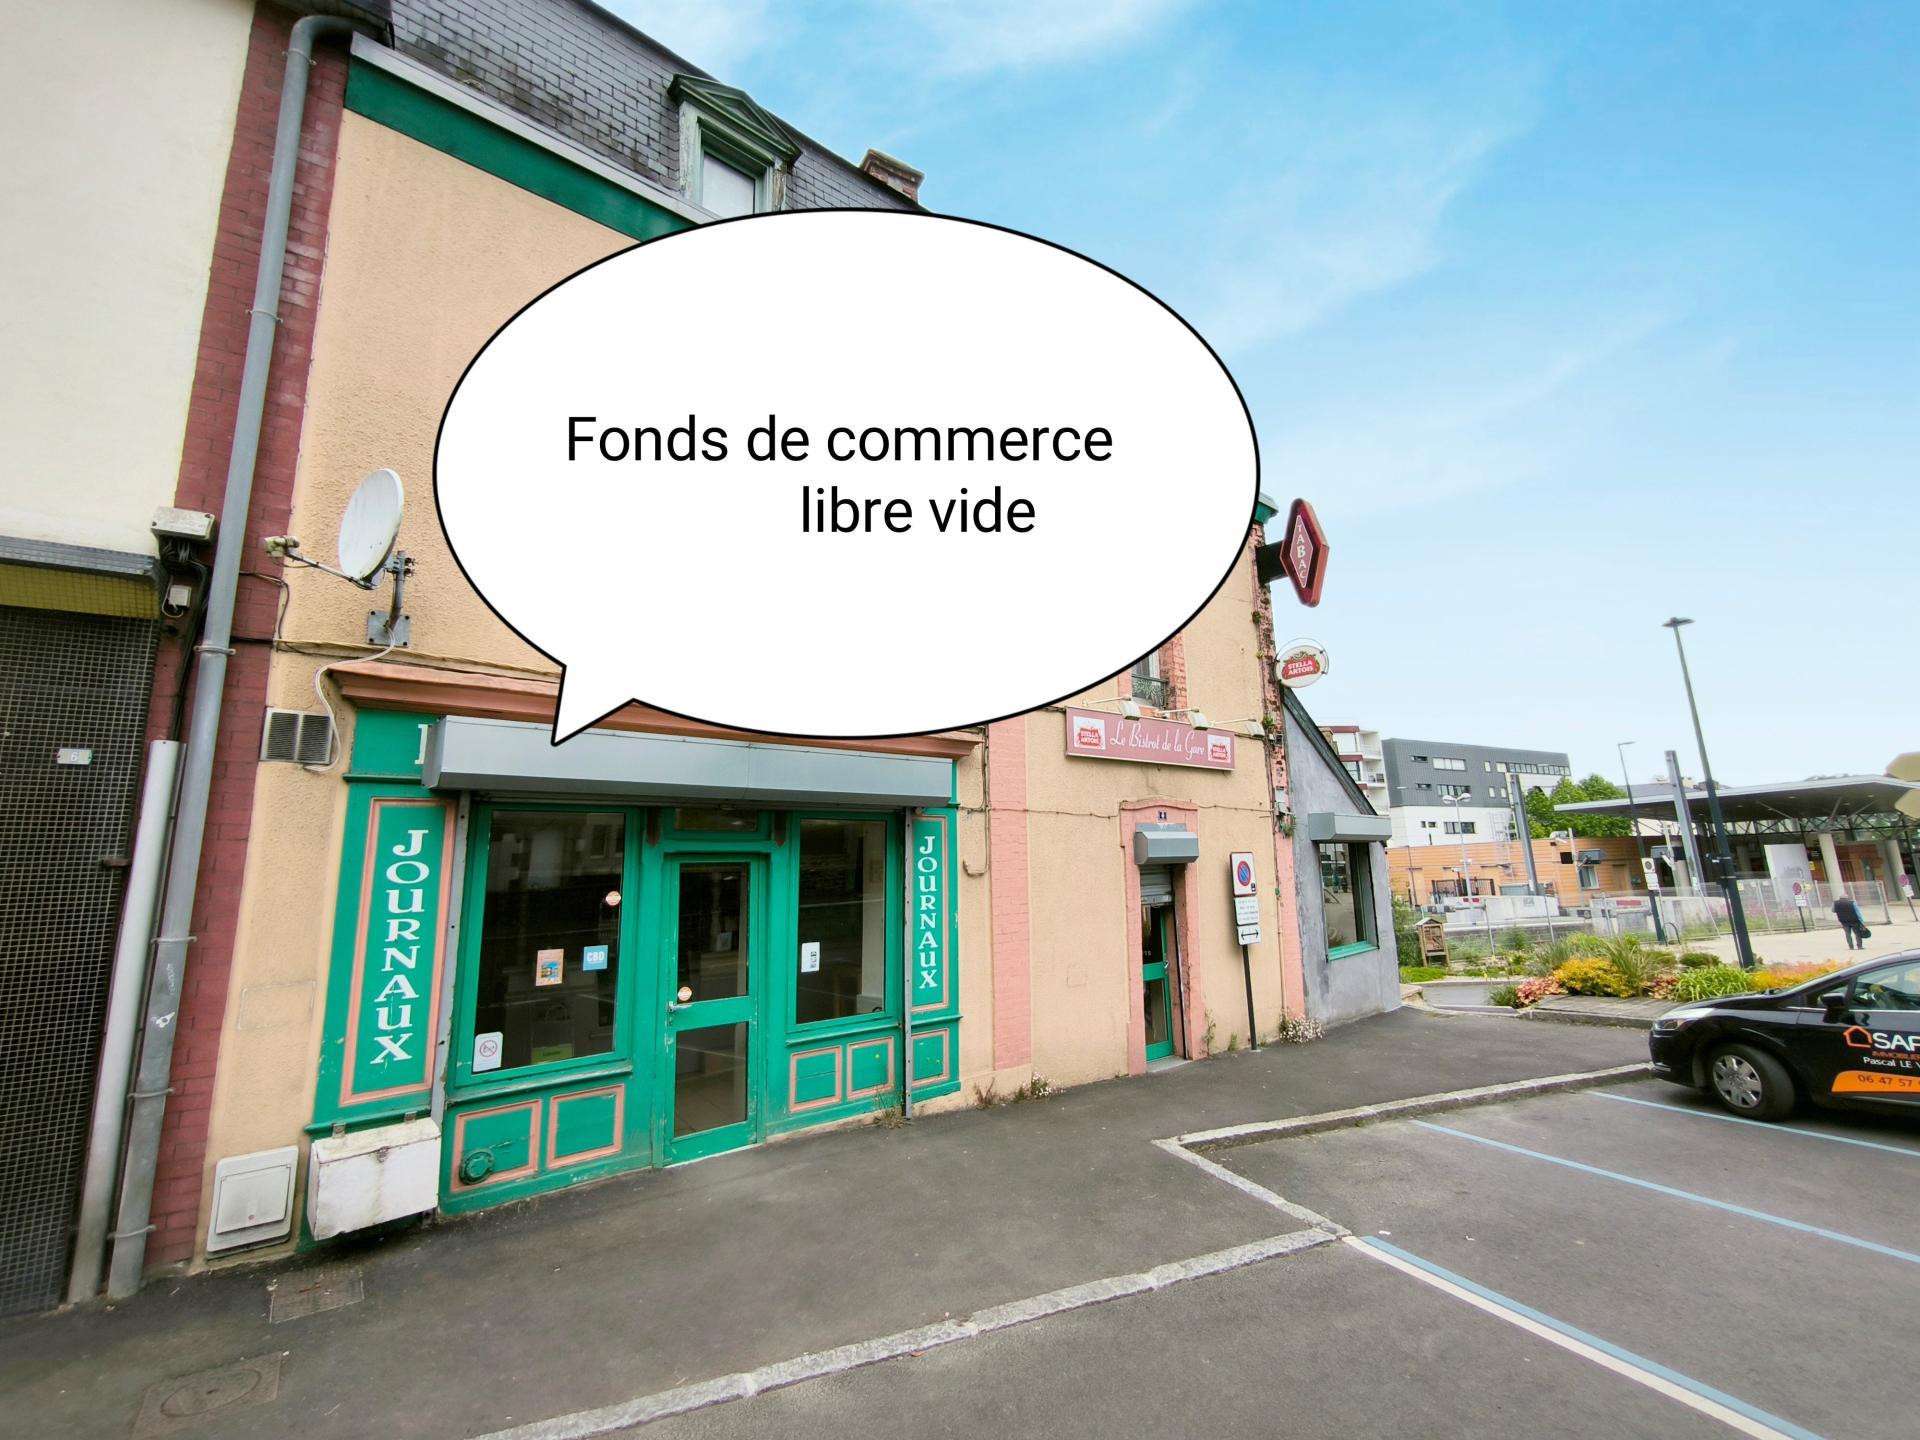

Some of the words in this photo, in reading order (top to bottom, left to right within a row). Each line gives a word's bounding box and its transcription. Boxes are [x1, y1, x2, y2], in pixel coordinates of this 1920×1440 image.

[1296, 524, 1306, 580] TABAC
[1288, 659, 1313, 670] STELLA
[1288, 666, 1314, 675] ARTOIS
[1109, 721, 1125, 746] Le
[1129, 722, 1160, 749] Bistrot
[1161, 732, 1173, 752] de
[1173, 732, 1183, 753] la
[1184, 732, 1206, 761] Gare
[917, 835, 938, 989] JOURNAUX
[370, 829, 430, 1065] JOURNAUX
[586, 951, 605, 962] CBD
[1862, 1056, 1896, 1067] Pascal
[1900, 1060, 1912, 1068] LE
[1857, 1074, 1874, 1083] 06
[1878, 1076, 1893, 1085] 47
[1898, 1078, 1912, 1087] 57
